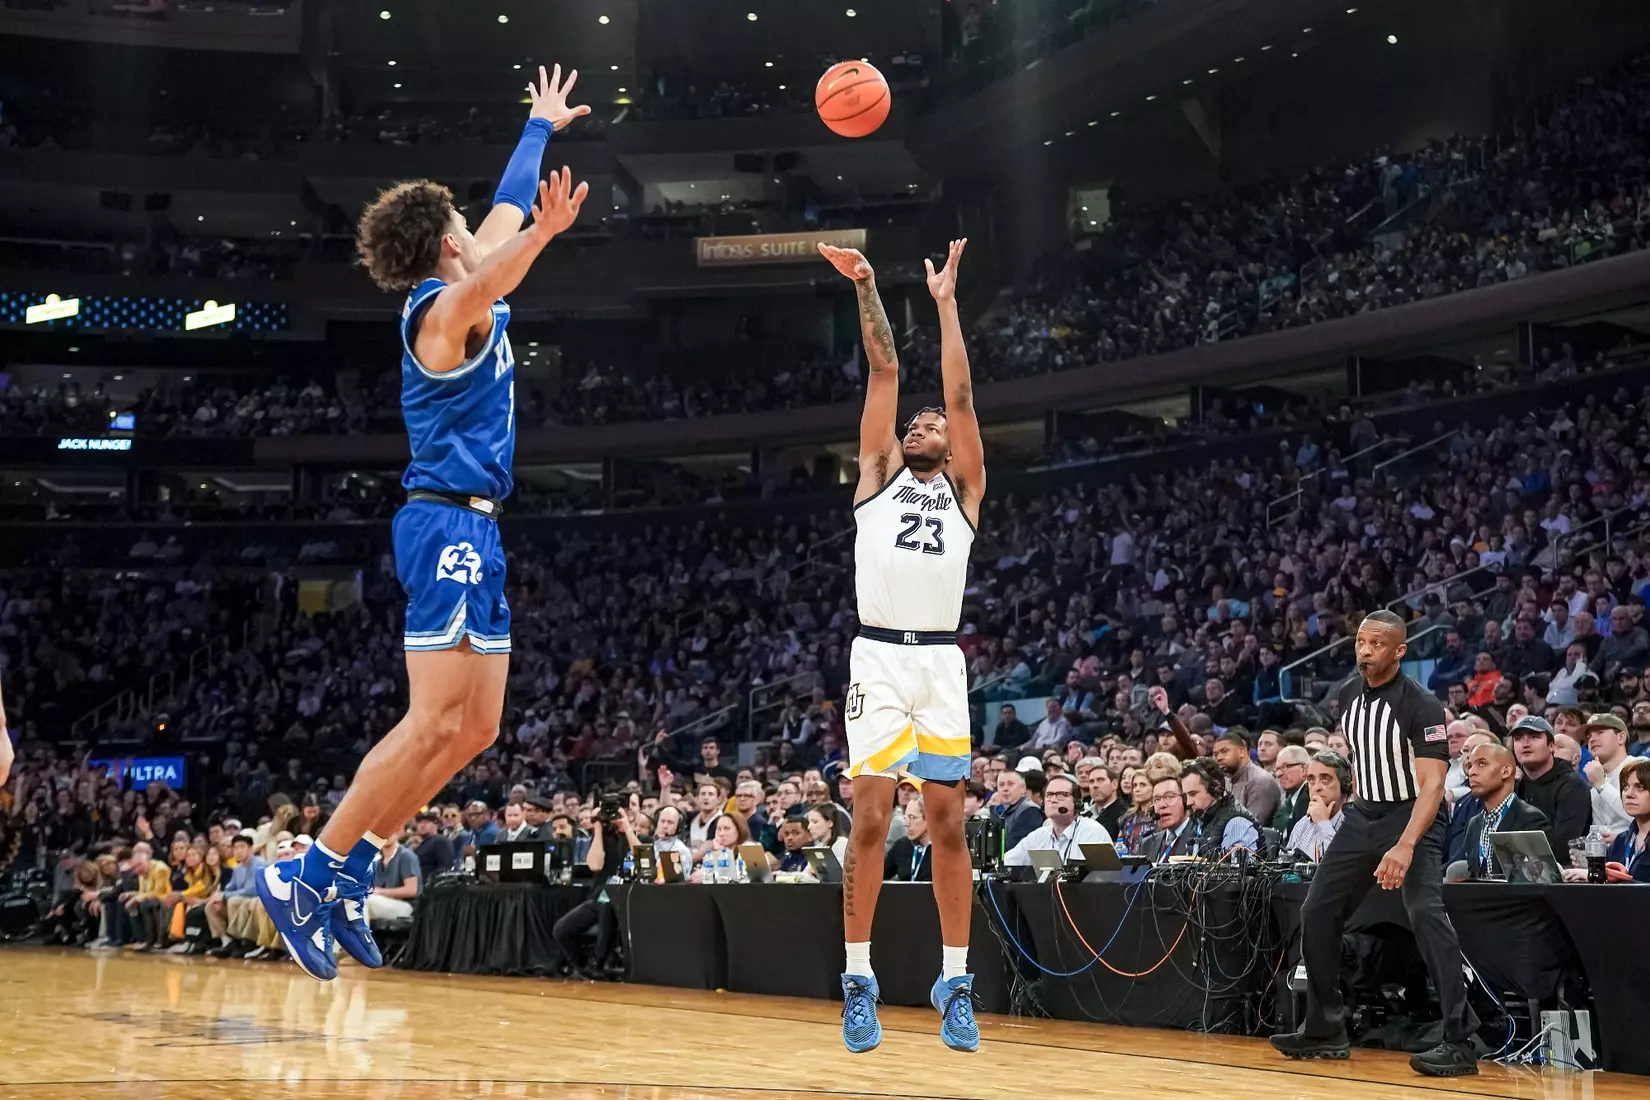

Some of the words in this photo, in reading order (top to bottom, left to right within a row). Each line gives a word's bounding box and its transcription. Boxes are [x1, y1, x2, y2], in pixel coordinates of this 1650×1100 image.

[760, 241, 807, 257] SUITE
[58, 438, 88, 450] JACK
[894, 512, 945, 555] 23
